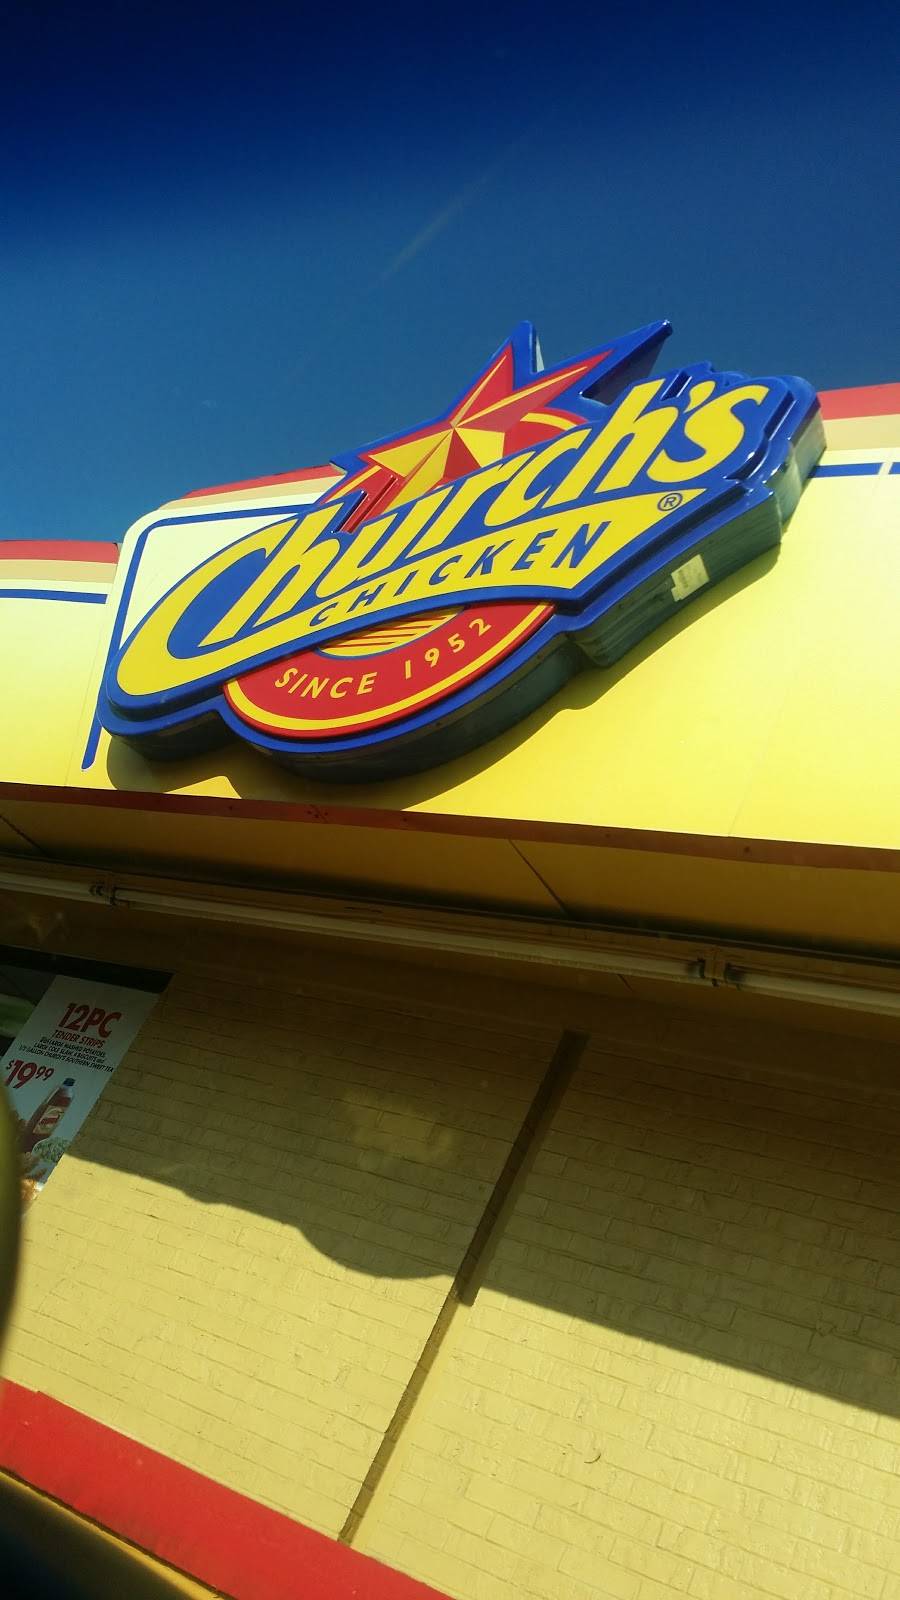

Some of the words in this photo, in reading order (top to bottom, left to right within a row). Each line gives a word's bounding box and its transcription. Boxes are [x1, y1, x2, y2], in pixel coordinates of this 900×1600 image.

[116, 377, 770, 696] Church's
[309, 520, 612, 627] CHICKEN
[274, 667, 378, 699] SINCE
[404, 618, 492, 680] 1952
[51, 1029, 80, 1043] TENDER
[78, 1035, 106, 1049] STRIPS
[58, 1003, 122, 1038] 12PC
